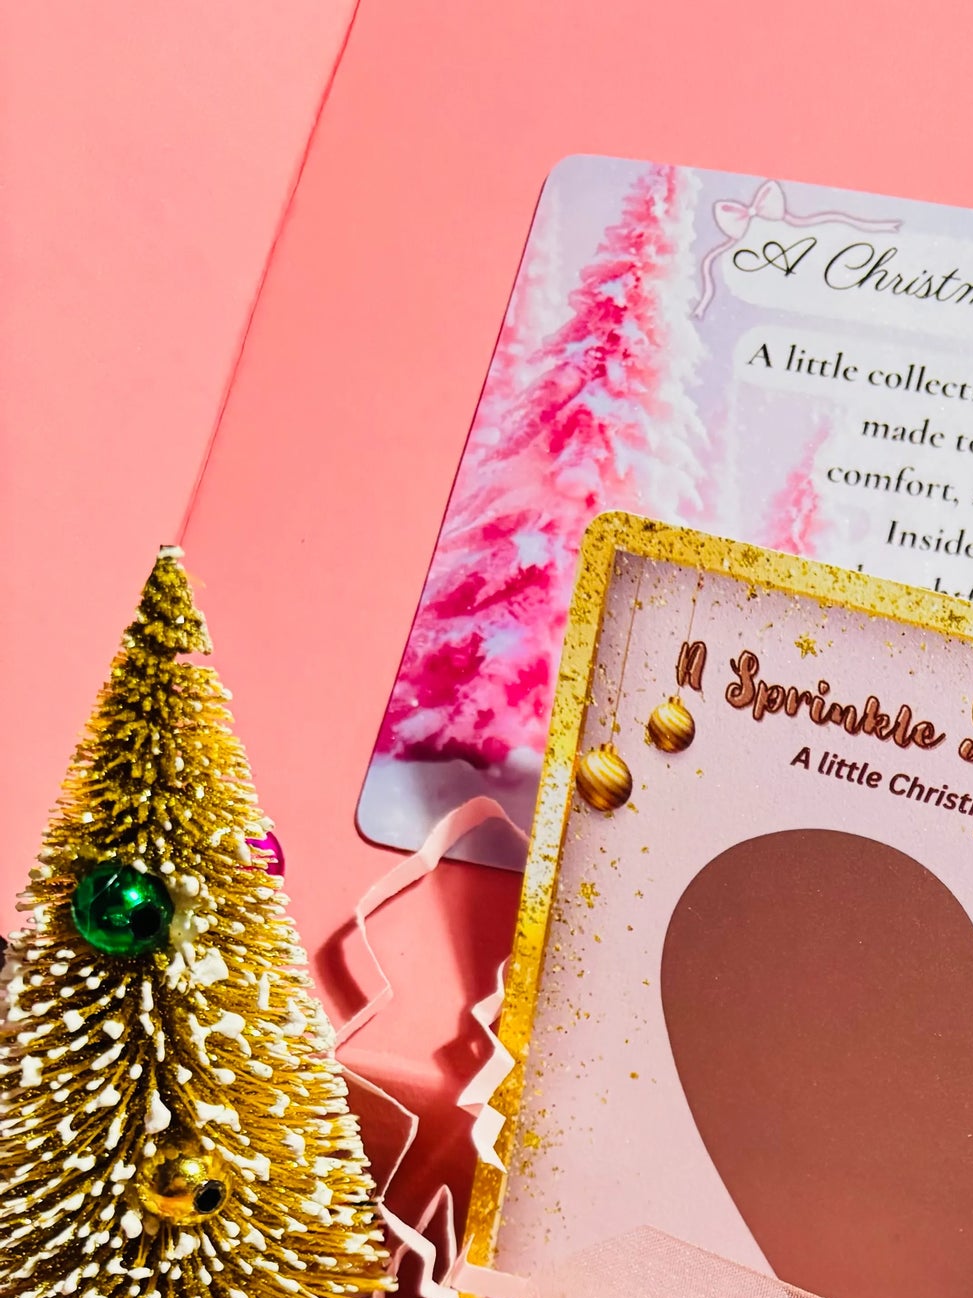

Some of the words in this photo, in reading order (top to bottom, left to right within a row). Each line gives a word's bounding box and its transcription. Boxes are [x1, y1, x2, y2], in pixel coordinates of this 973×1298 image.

[733, 237, 816, 277] A
[746, 341, 773, 370] A
[785, 345, 859, 383] little
[861, 416, 945, 450] made
[826, 461, 960, 506] comfort,
[726, 649, 946, 754] Sprinkle
[790, 746, 813, 771] A
[816, 751, 882, 792] little
